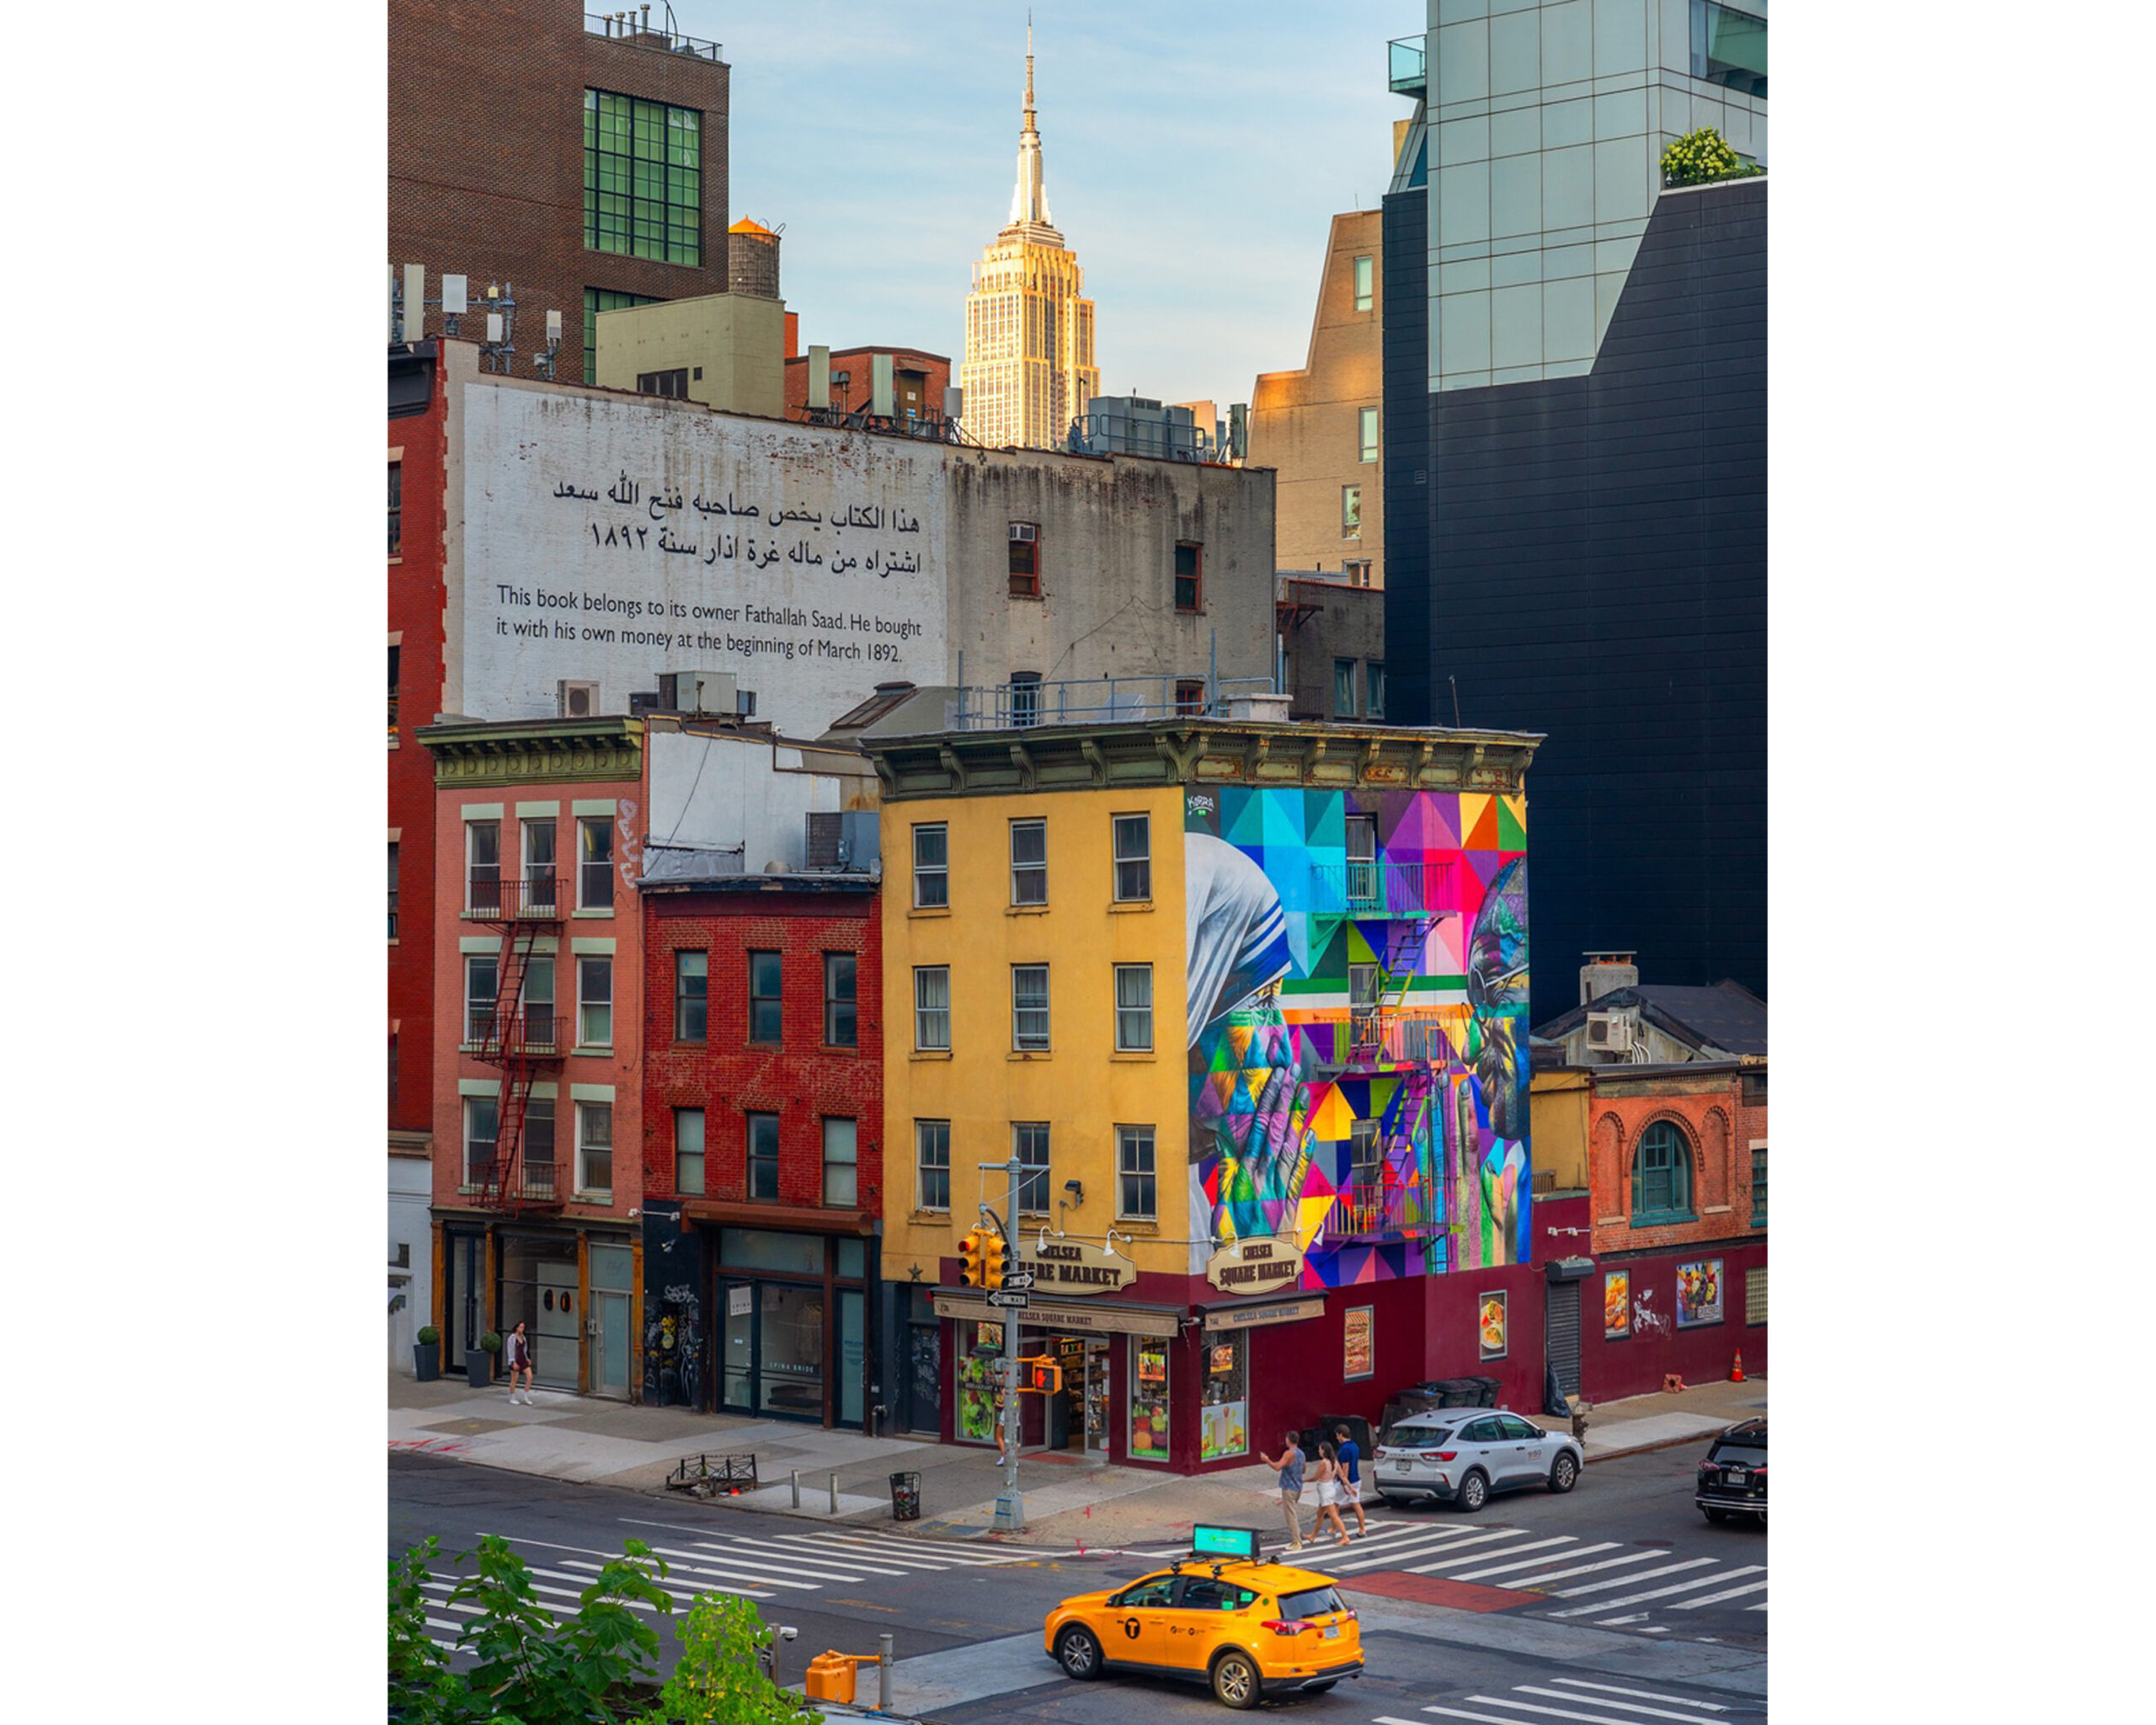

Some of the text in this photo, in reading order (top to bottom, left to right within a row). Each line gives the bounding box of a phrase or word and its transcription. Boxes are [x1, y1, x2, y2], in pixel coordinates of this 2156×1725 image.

[552, 469, 920, 535] هذا الكتاب يخص صاحبه فتح الله سعد
[591, 522, 921, 578] اشتراه من ماله غرة اذار سنة ١٨٩٢
[497, 584, 923, 640] This book belongs to its owner Fathallah Saad. He bought
[497, 617, 903, 664] it with his own money at the beginning of March 1892.
[1242, 1243, 1273, 1261] CHELSEA
[1058, 1264, 1121, 1286] MARKET
[1219, 1260, 1296, 1286] SQUARE MARKET
[1017, 1311, 1092, 1326] HELSEA SQUARE MARKET
[769, 1361, 814, 1373] SPINA BRIDE
